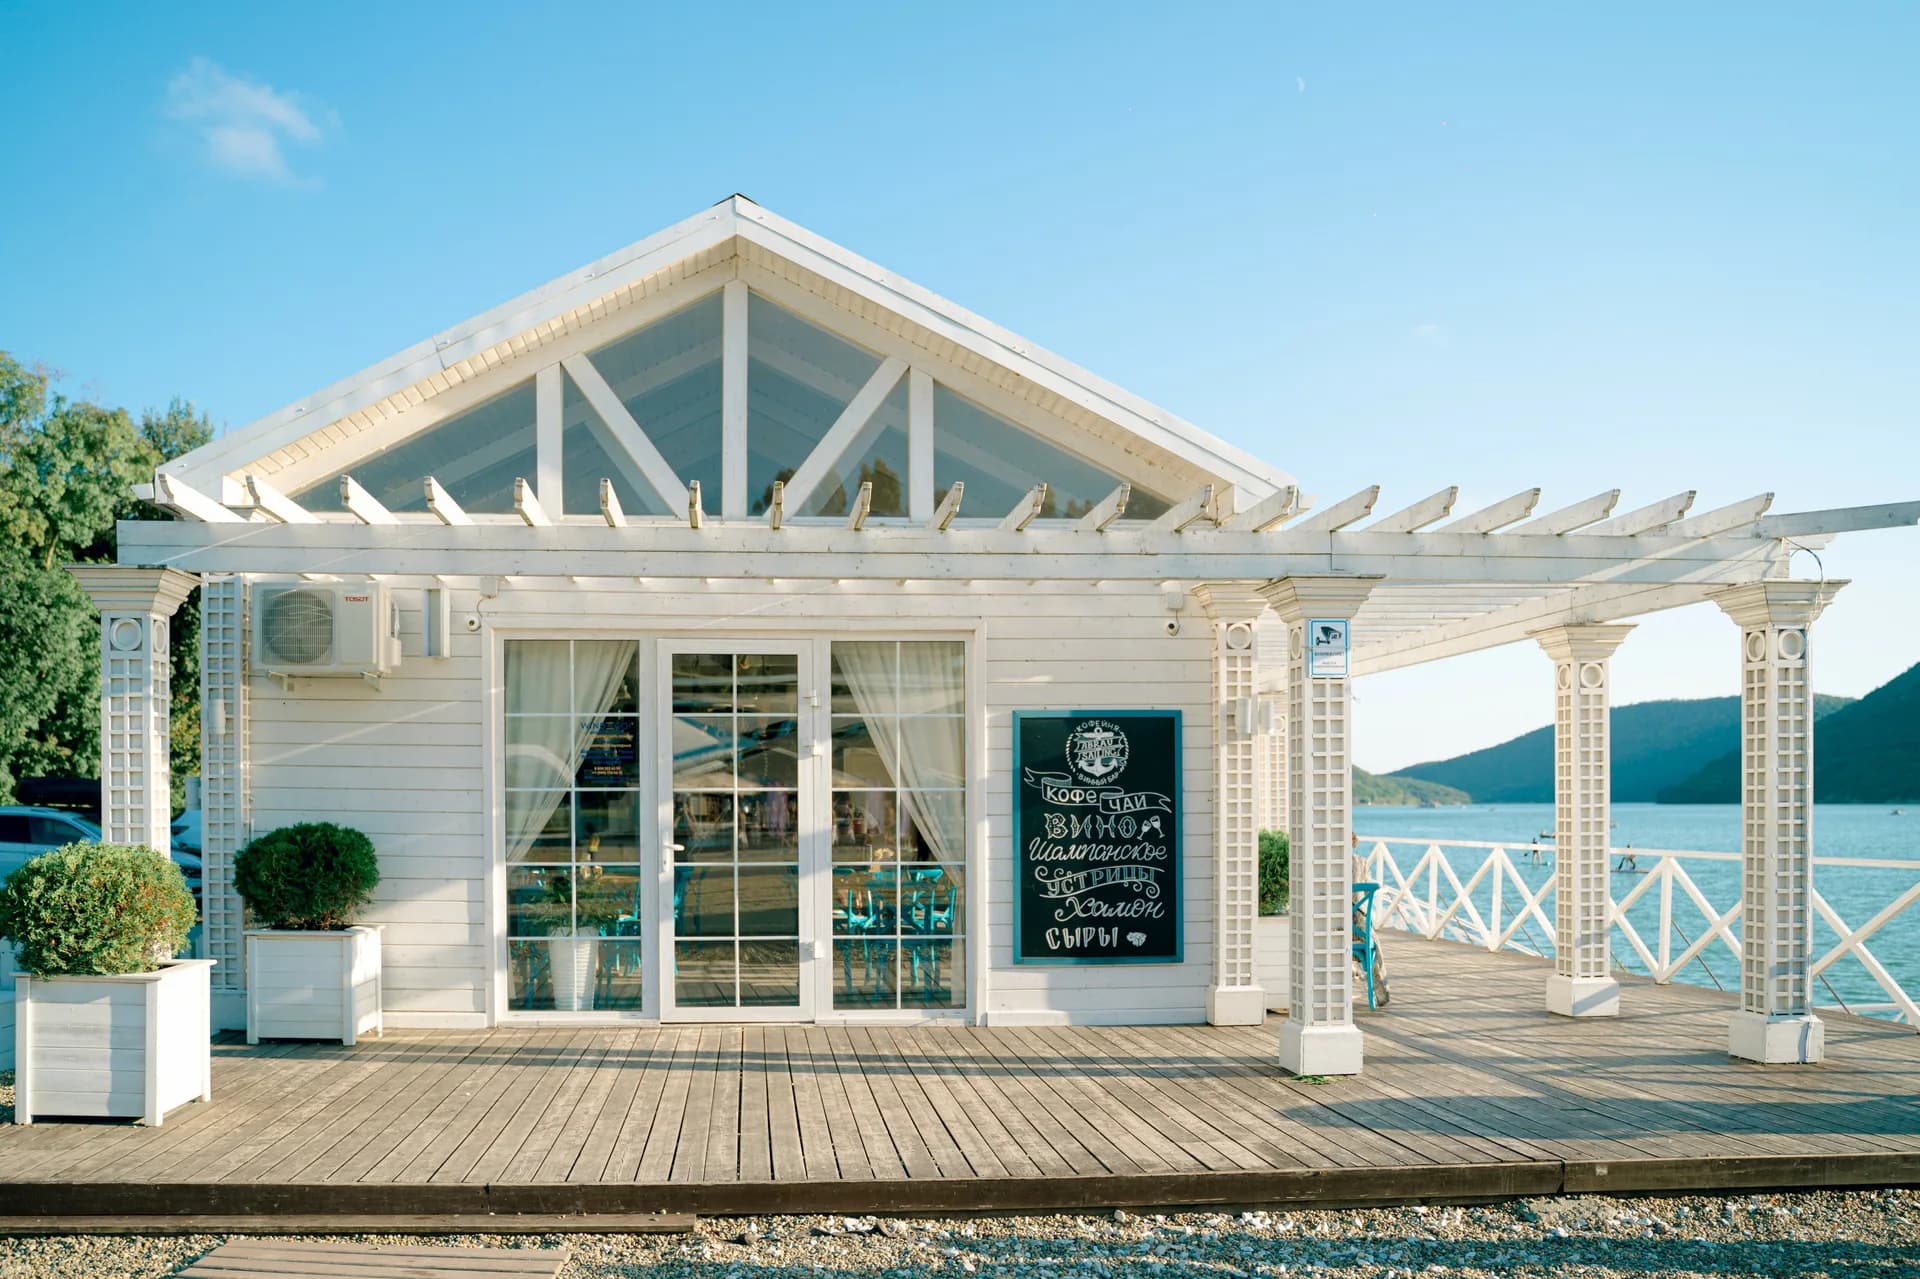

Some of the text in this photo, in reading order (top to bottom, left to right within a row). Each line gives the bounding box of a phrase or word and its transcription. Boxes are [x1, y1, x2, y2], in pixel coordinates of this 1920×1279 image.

[1075, 720, 1120, 732] КОФЕЙНЯ
[1081, 739, 1114, 750] ABRAU
[1078, 771, 1119, 785] ВИННЫЙ БАР
[1109, 794, 1147, 812] ЧАЙ
[1044, 812, 1138, 839] ВИНО
[1028, 836, 1168, 862] Шампанское
[1046, 867, 1155, 896] УСТРИЦЫ
[1054, 896, 1165, 922] Хамон
[1045, 926, 1118, 950] СЫРЫ
